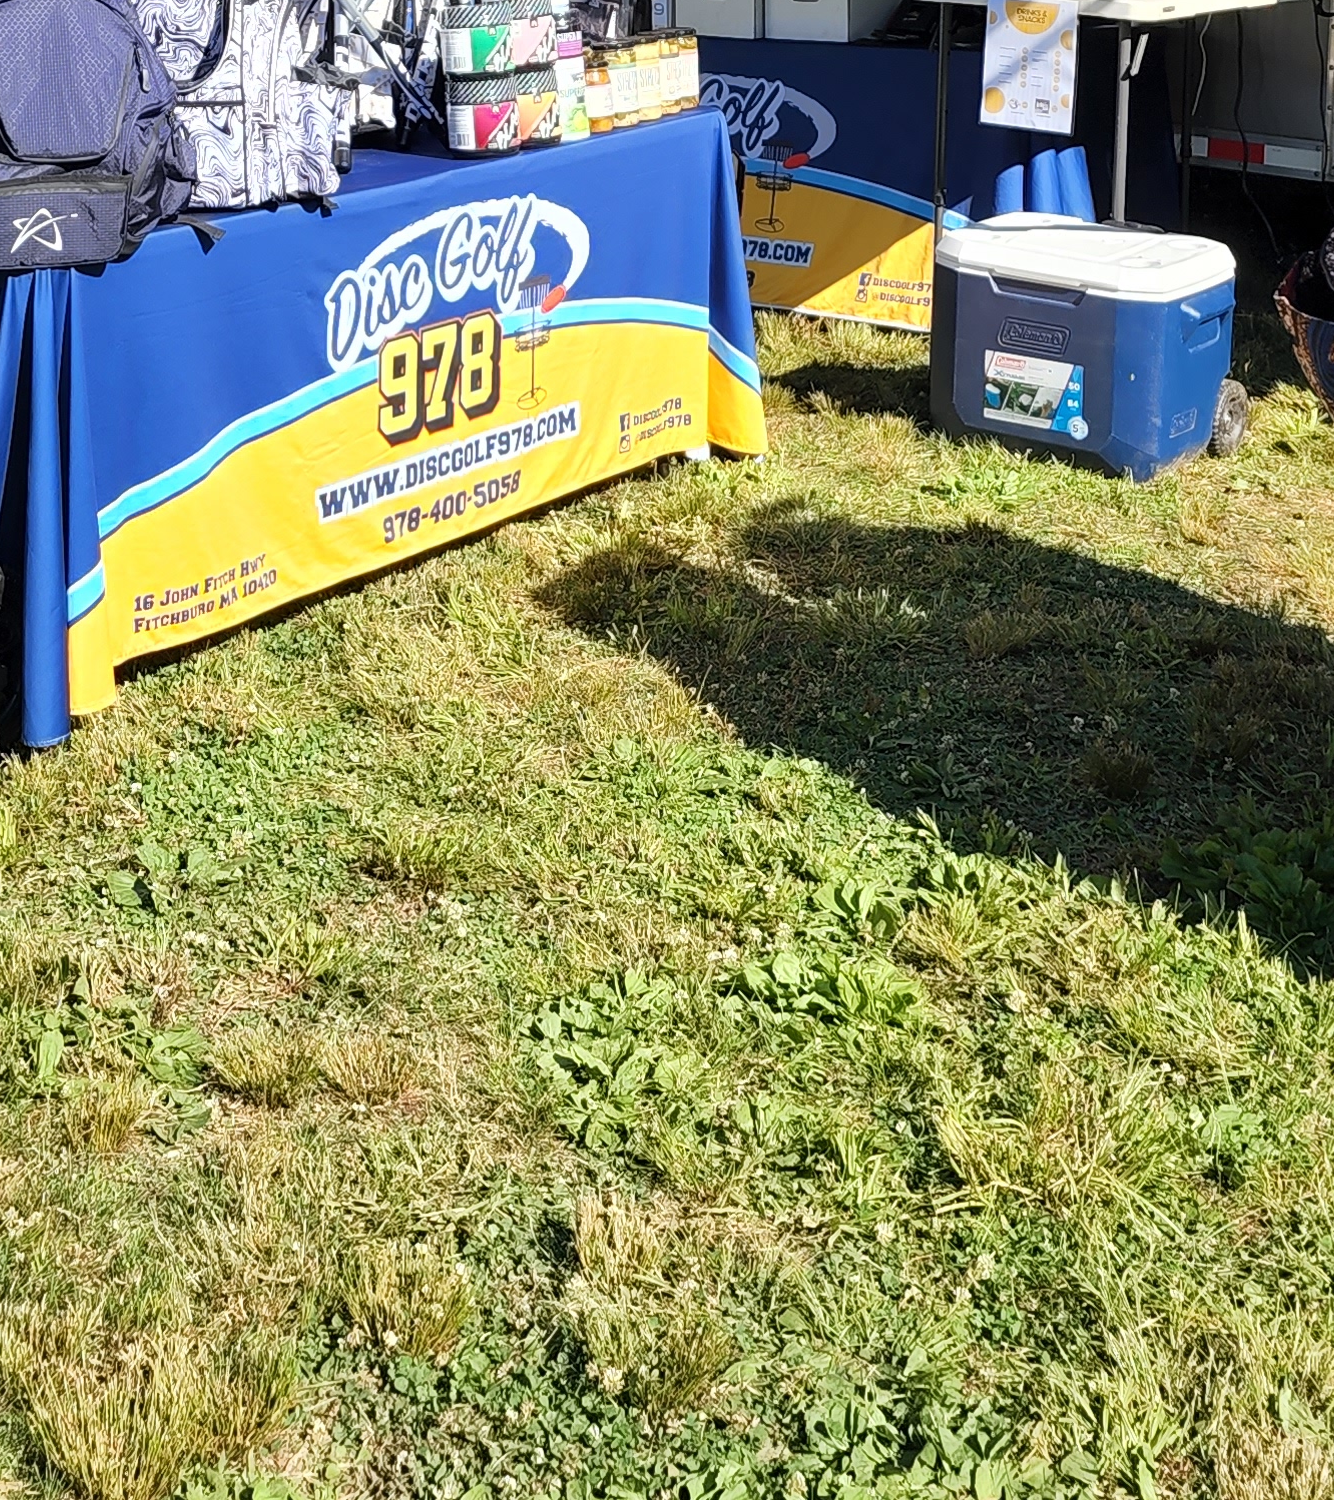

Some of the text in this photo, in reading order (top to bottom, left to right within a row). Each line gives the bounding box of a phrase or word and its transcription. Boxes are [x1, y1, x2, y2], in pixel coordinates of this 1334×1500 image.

[1016, 7, 1042, 18] DRINKS
[327, 199, 531, 365] Disc Golf
[873, 278, 932, 292] DISCGOLF97
[378, 308, 502, 447] 978
[319, 407, 577, 519] WWW.DISCGOLF978.COM
[383, 469, 522, 544] 978-400-5058
[134, 594, 155, 612] 16
[219, 586, 239, 610] MA
[242, 569, 278, 599] 10420
